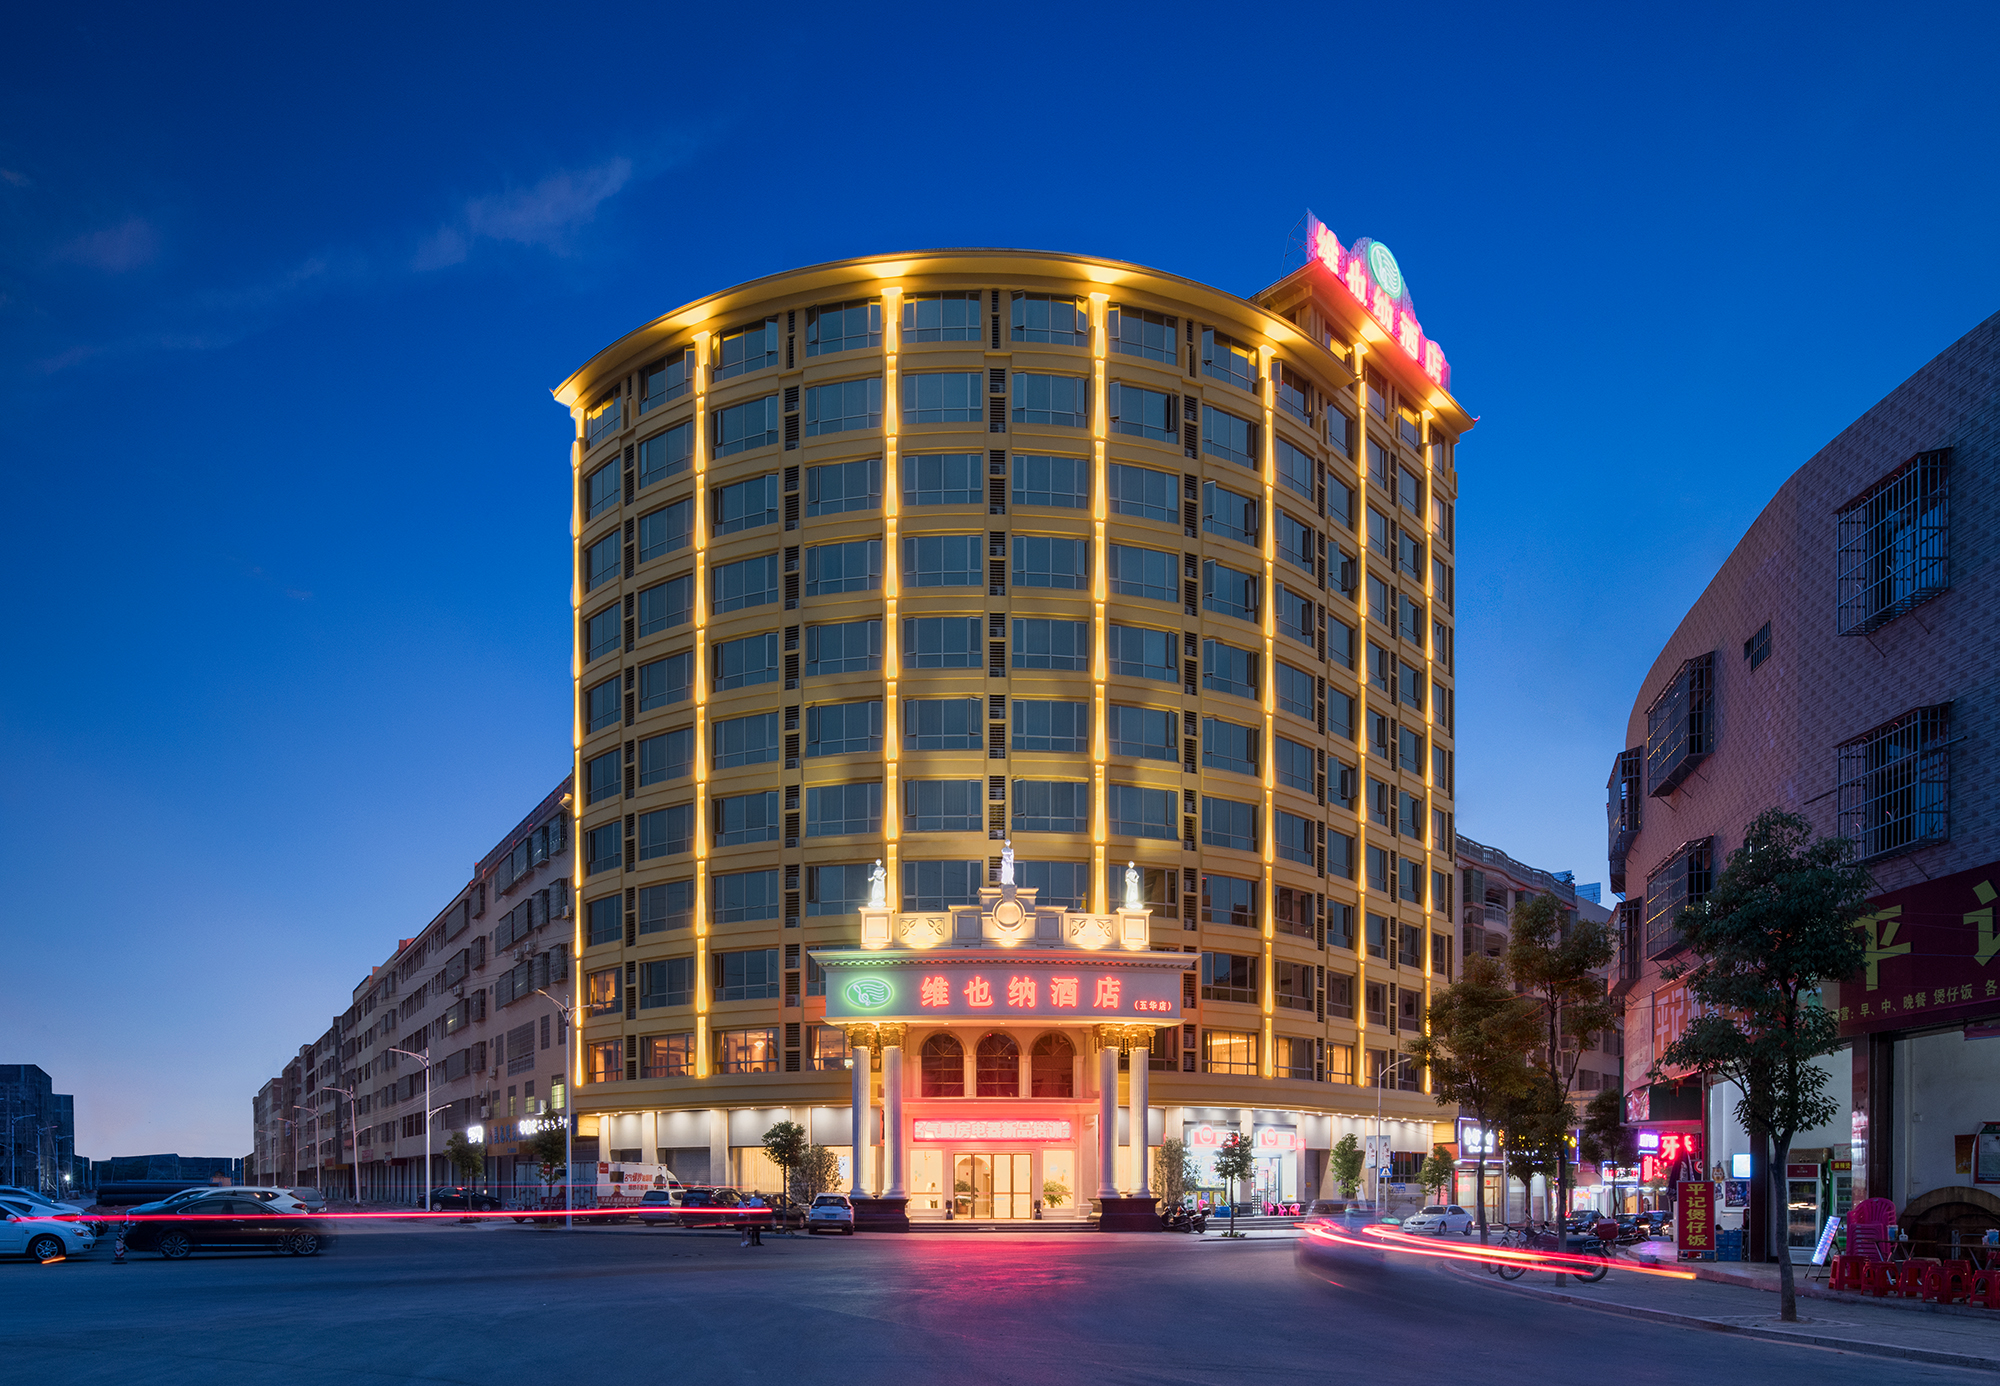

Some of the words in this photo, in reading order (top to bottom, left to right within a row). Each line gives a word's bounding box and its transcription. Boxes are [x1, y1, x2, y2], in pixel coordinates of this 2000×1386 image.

[1316, 222, 1443, 385] 维也纳酒店
[921, 976, 1121, 1009] 维也纳酒店
[1933, 983, 1973, 1005] 煲仔饭
[1985, 979, 1998, 996] 各
[1686, 1184, 1707, 1246] 平记煲仔饭
